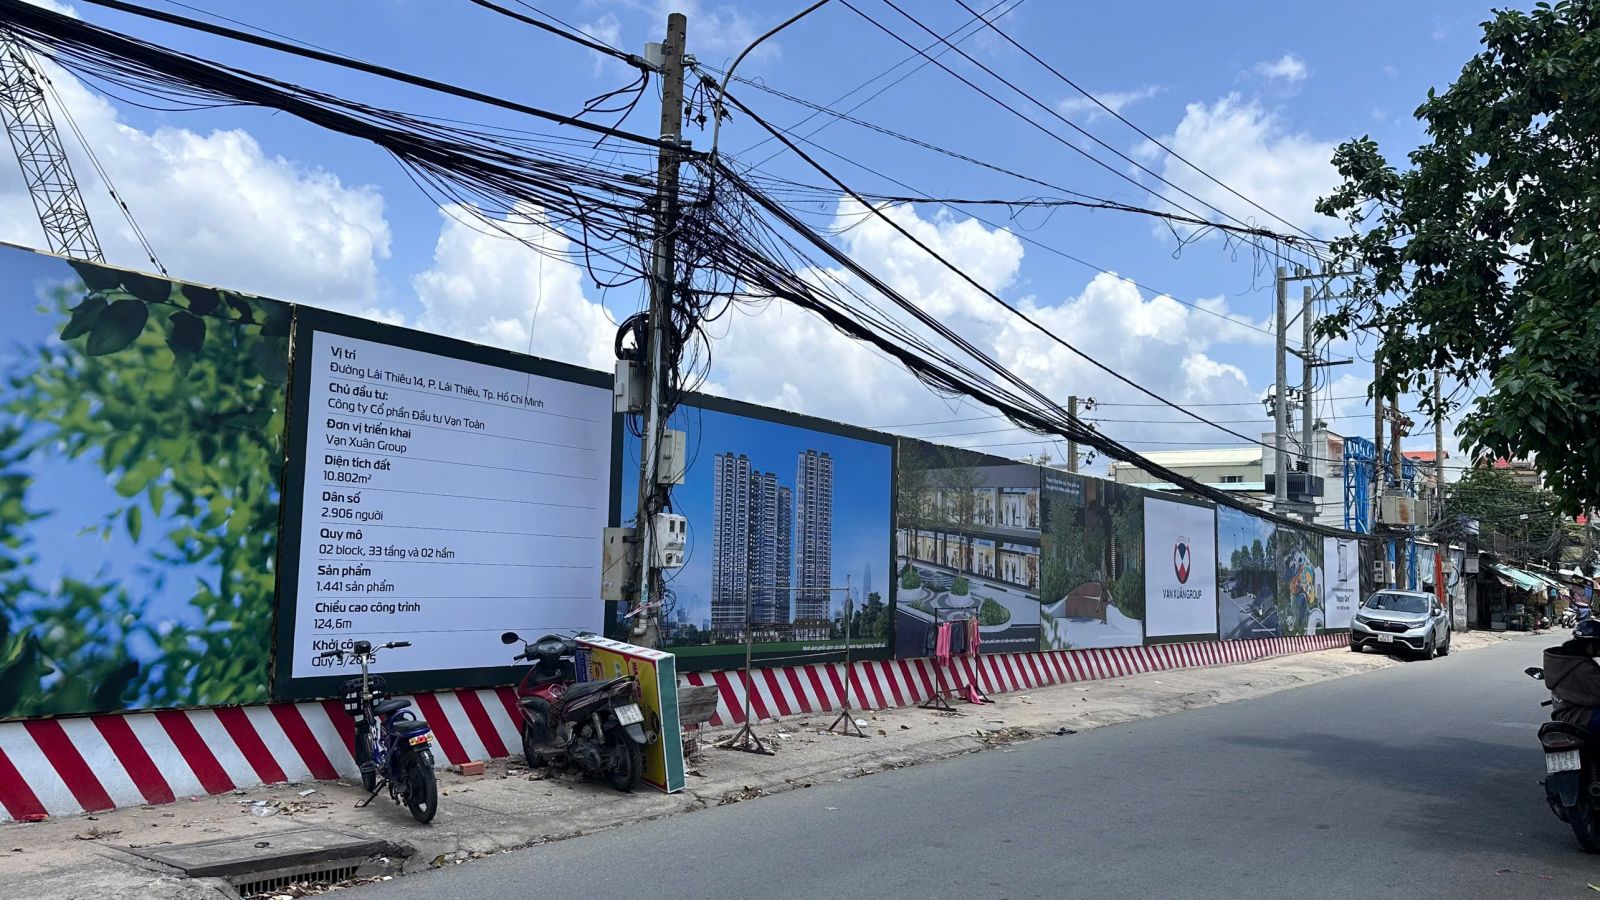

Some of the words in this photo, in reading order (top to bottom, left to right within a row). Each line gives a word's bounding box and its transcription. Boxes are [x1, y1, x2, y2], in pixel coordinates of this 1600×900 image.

[330, 346, 342, 359] Vị
[344, 348, 356, 360] trí
[329, 382, 350, 394] Chủ
[353, 385, 372, 398] đầu
[375, 390, 388, 400] tư:
[330, 362, 364, 378] Đường
[368, 368, 382, 380] Lái
[385, 371, 411, 385] Thiêu
[414, 376, 426, 388] 14,
[428, 379, 437, 389] P.
[439, 381, 452, 392] Lái
[454, 384, 480, 398] Thiêu,
[482, 389, 495, 400] Tp.
[497, 391, 509, 402] Hồ
[511, 394, 523, 404] Chí
[525, 397, 544, 408] Minh
[328, 398, 355, 413] Công
[357, 402, 368, 414] ty
[370, 403, 384, 414] Cổ
[412, 410, 431, 422] Đầu
[433, 414, 443, 423] tư
[444, 415, 461, 427] Vạn
[463, 418, 485, 430] Toàn
[326, 418, 350, 431] Đơn
[352, 423, 361, 434] vị
[364, 422, 387, 435] triển
[390, 427, 411, 439] khai
[326, 434, 346, 446] Vạn
[349, 437, 375, 449] Xuân
[377, 441, 406, 454] Group
[325, 455, 349, 468] Diện
[352, 457, 371, 469] tích
[374, 458, 391, 471] đất
[322, 492, 344, 502] Dân
[347, 491, 361, 504] số
[321, 507, 353, 518] 2.906
[356, 510, 383, 522] người
[320, 528, 344, 541] Quy
[346, 529, 362, 540] mô
[319, 544, 333, 554] 02
[336, 545, 366, 556] block,
[369, 546, 382, 556] 33
[384, 545, 405, 558] tầng
[408, 547, 419, 558] và
[421, 548, 434, 558] 02
[435, 547, 455, 558] hầm
[318, 564, 339, 576] Sản
[342, 563, 371, 578] phẩm
[317, 581, 342, 592] 1.441
[345, 581, 364, 592] sản
[367, 579, 394, 594] phẩm
[315, 600, 346, 613] Chiều
[348, 604, 368, 613] cao
[370, 602, 395, 614] công
[398, 602, 420, 612] trình
[314, 619, 352, 630] 124,6m
[312, 639, 339, 651] Khởi
